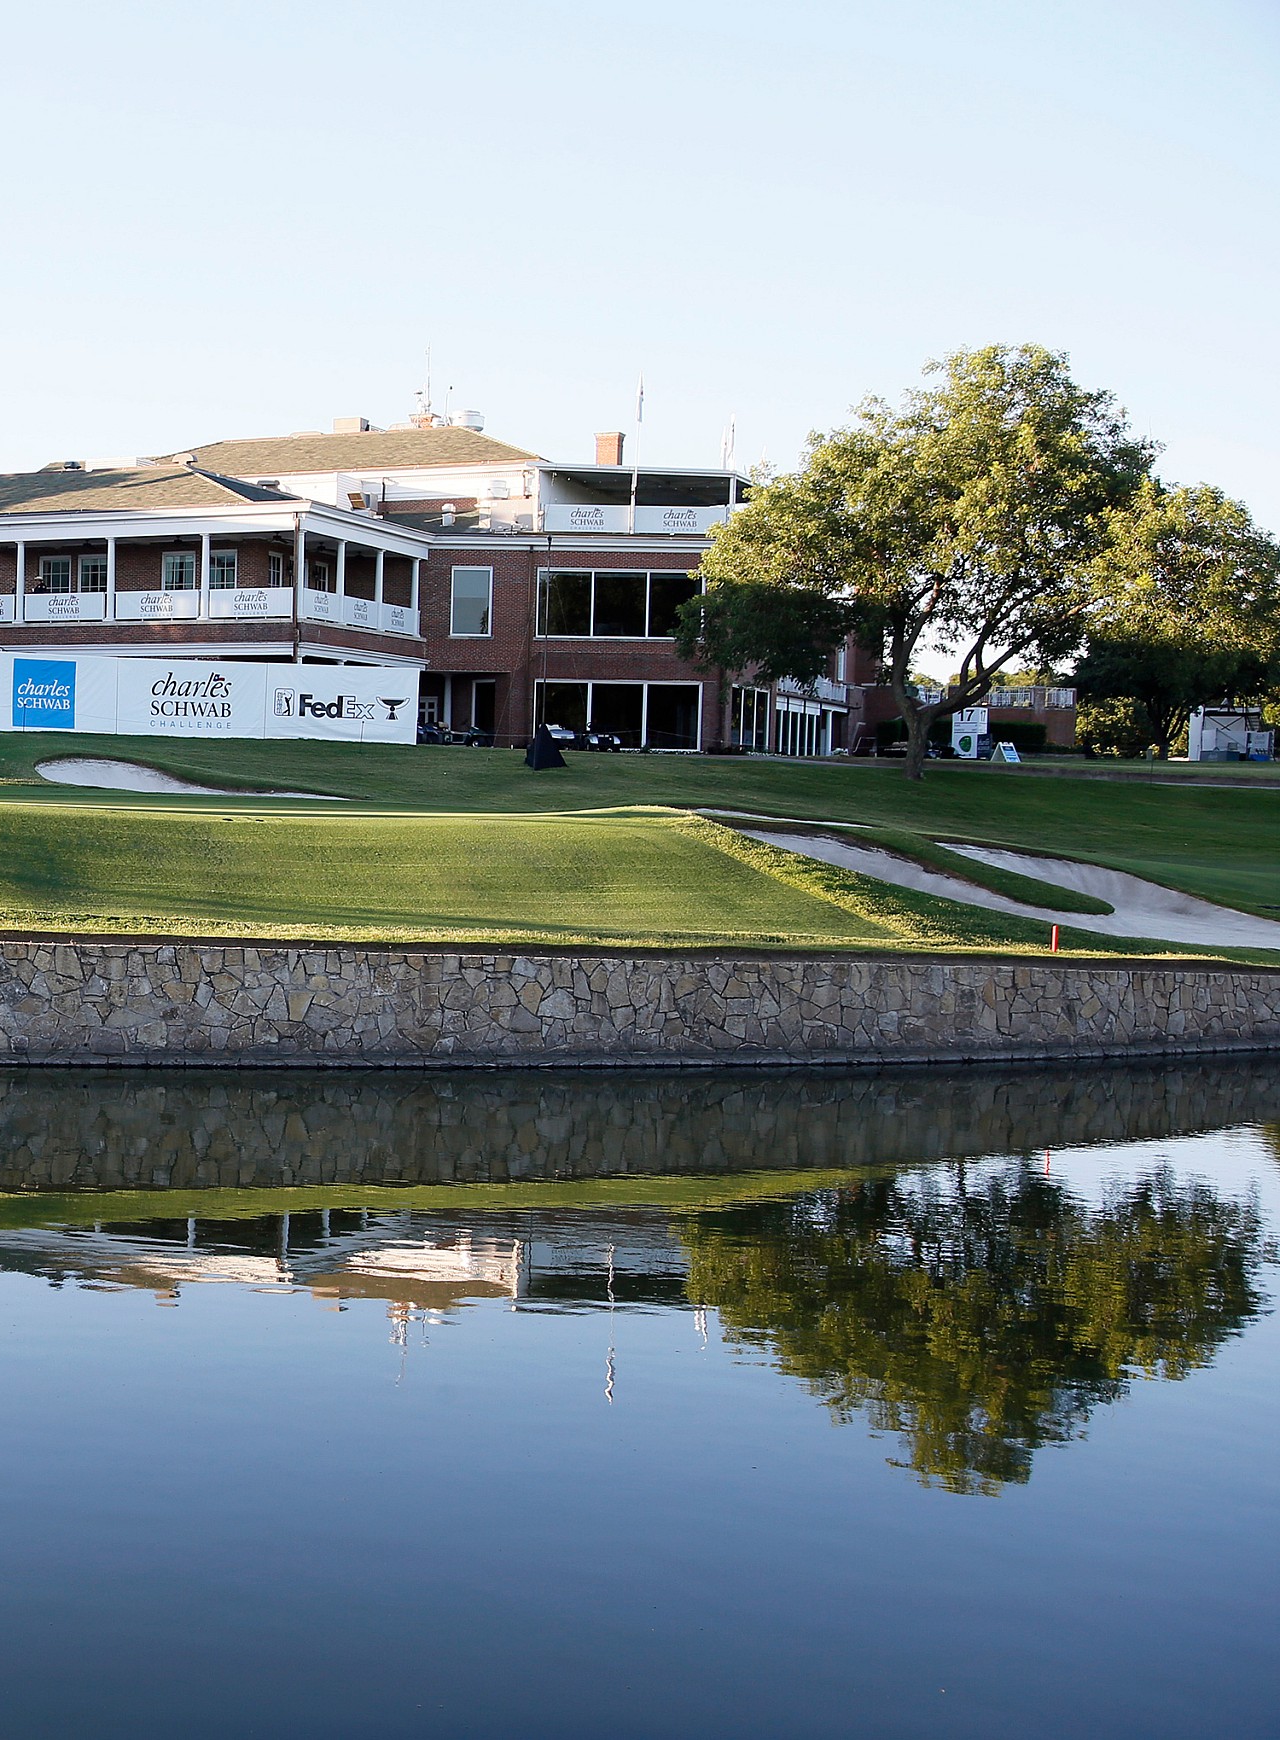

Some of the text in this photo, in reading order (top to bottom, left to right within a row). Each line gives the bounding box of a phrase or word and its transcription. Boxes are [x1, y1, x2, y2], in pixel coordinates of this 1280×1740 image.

[570, 508, 604, 518] charles
[664, 510, 697, 520] charles
[663, 520, 697, 528] SCHWAB
[48, 595, 80, 606] charles
[140, 592, 173, 604] charles
[234, 590, 268, 602] charles
[48, 607, 80, 615] SCHWAB
[17, 678, 70, 696] charles
[152, 672, 232, 698] charles
[17, 697, 70, 710] SCHWAB
[150, 700, 232, 718] SCHWAB
[298, 694, 375, 720] FedEx
[958, 710, 974, 722] 17
[150, 720, 232, 730] CHALLENGE
